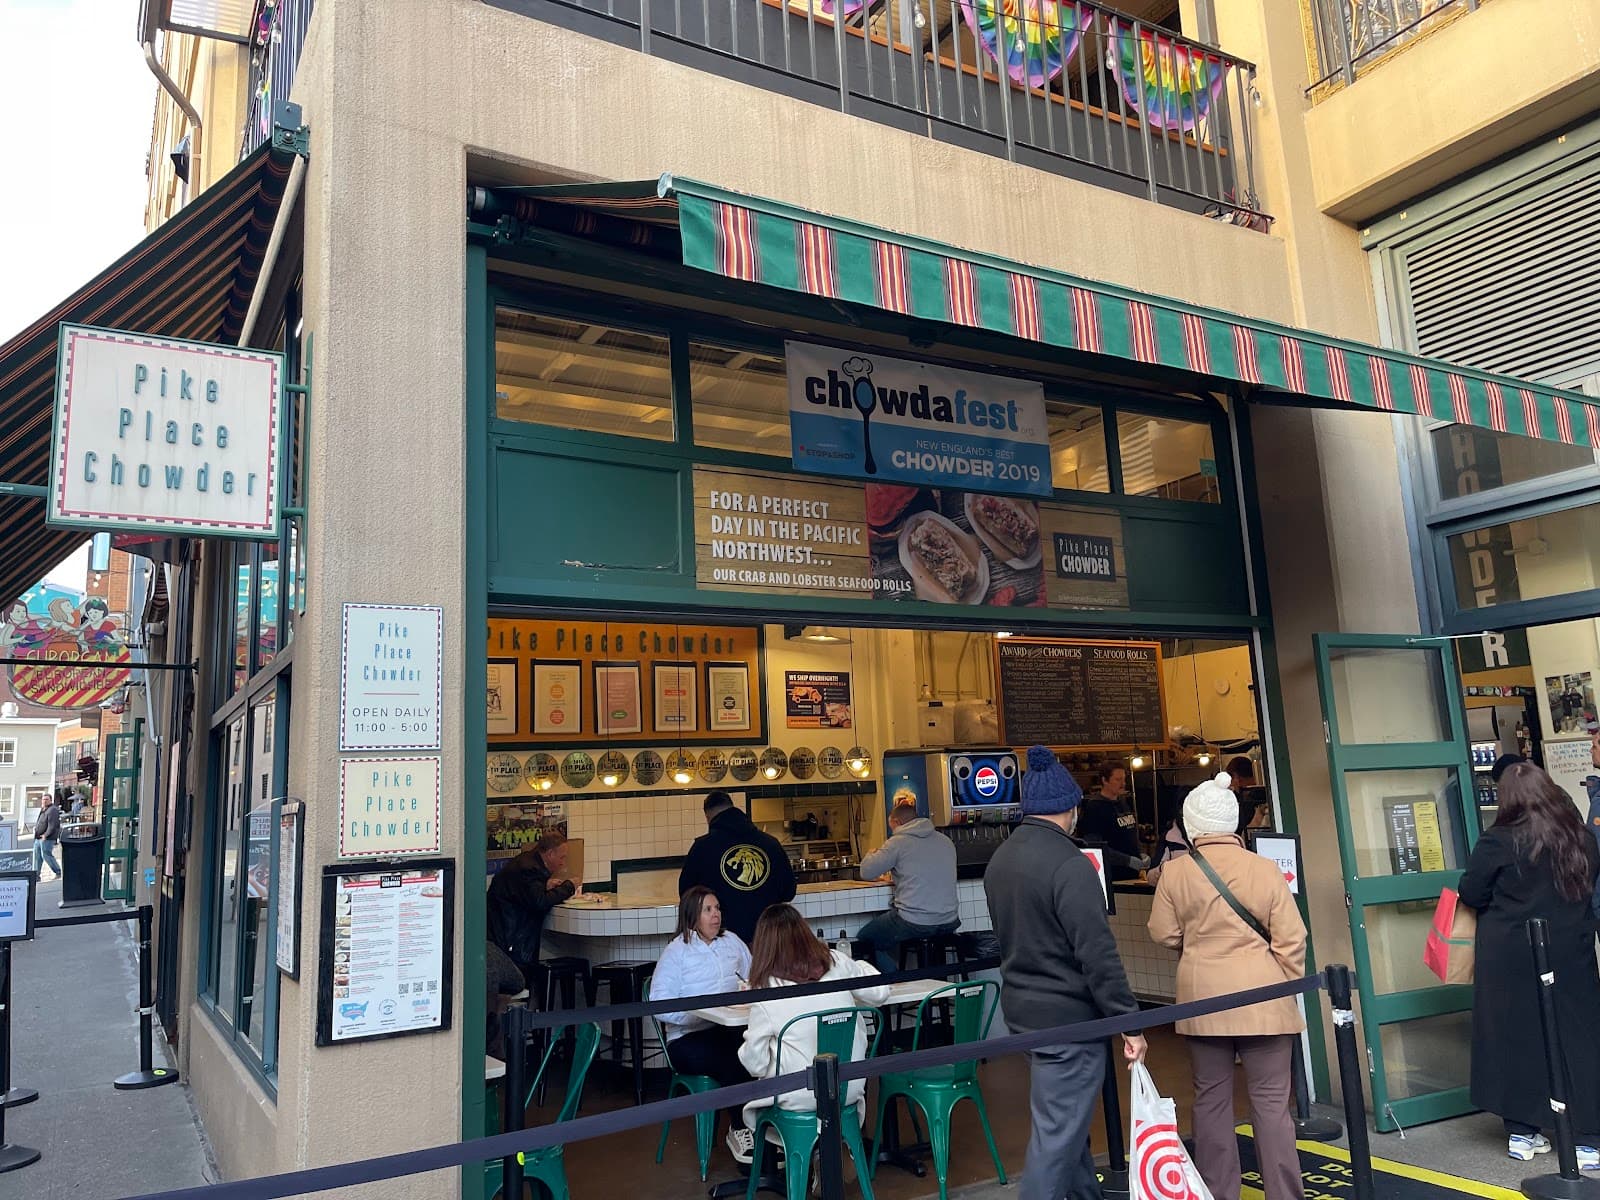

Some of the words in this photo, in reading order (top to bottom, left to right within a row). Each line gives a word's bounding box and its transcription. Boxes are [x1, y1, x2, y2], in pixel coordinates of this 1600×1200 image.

[134, 363, 219, 403] Pike
[805, 369, 1019, 433] chowdafest
[118, 408, 229, 448] Place
[915, 439, 939, 451] NEW
[940, 442, 992, 458] ENGLAND'S
[995, 448, 1015, 460] BEST
[84, 451, 257, 496] Chowder
[891, 449, 994, 478] CHOWDER
[998, 461, 1040, 482] 2019
[710, 490, 744, 512] FOR
[747, 494, 758, 513] A
[762, 495, 829, 520] PERFECT
[711, 515, 743, 535] DAY
[747, 518, 765, 537] IN
[769, 520, 800, 540] THE
[803, 523, 861, 545] PACIFIC
[712, 540, 832, 567] NORTHWEST...
[1059, 538, 1079, 554] Pike
[1083, 540, 1109, 556] Place
[1061, 554, 1111, 576] CHOWDER
[713, 568, 736, 582] OUR
[738, 569, 766, 584] CRAB
[768, 571, 790, 585] AND
[793, 573, 836, 588] LOBSTER
[838, 575, 881, 590] SEAFOOD
[882, 578, 912, 592] ROLLS
[378, 622, 409, 638] Pike
[556, 628, 623, 653] Place
[638, 630, 735, 654] Chowder
[374, 643, 412, 660] Place
[1000, 645, 1027, 657] AWARD
[1126, 650, 1148, 659] ROLLS
[363, 665, 421, 682] Chowder
[352, 707, 389, 718] OPEN
[395, 707, 431, 718] DAILY
[355, 722, 386, 732] 11:00
[401, 722, 428, 732] 5:00
[574, 764, 593, 772] PLACE
[372, 771, 412, 788] Pike
[366, 796, 417, 812] Place
[351, 819, 431, 838] Chowder
[1273, 858, 1293, 868] TER
